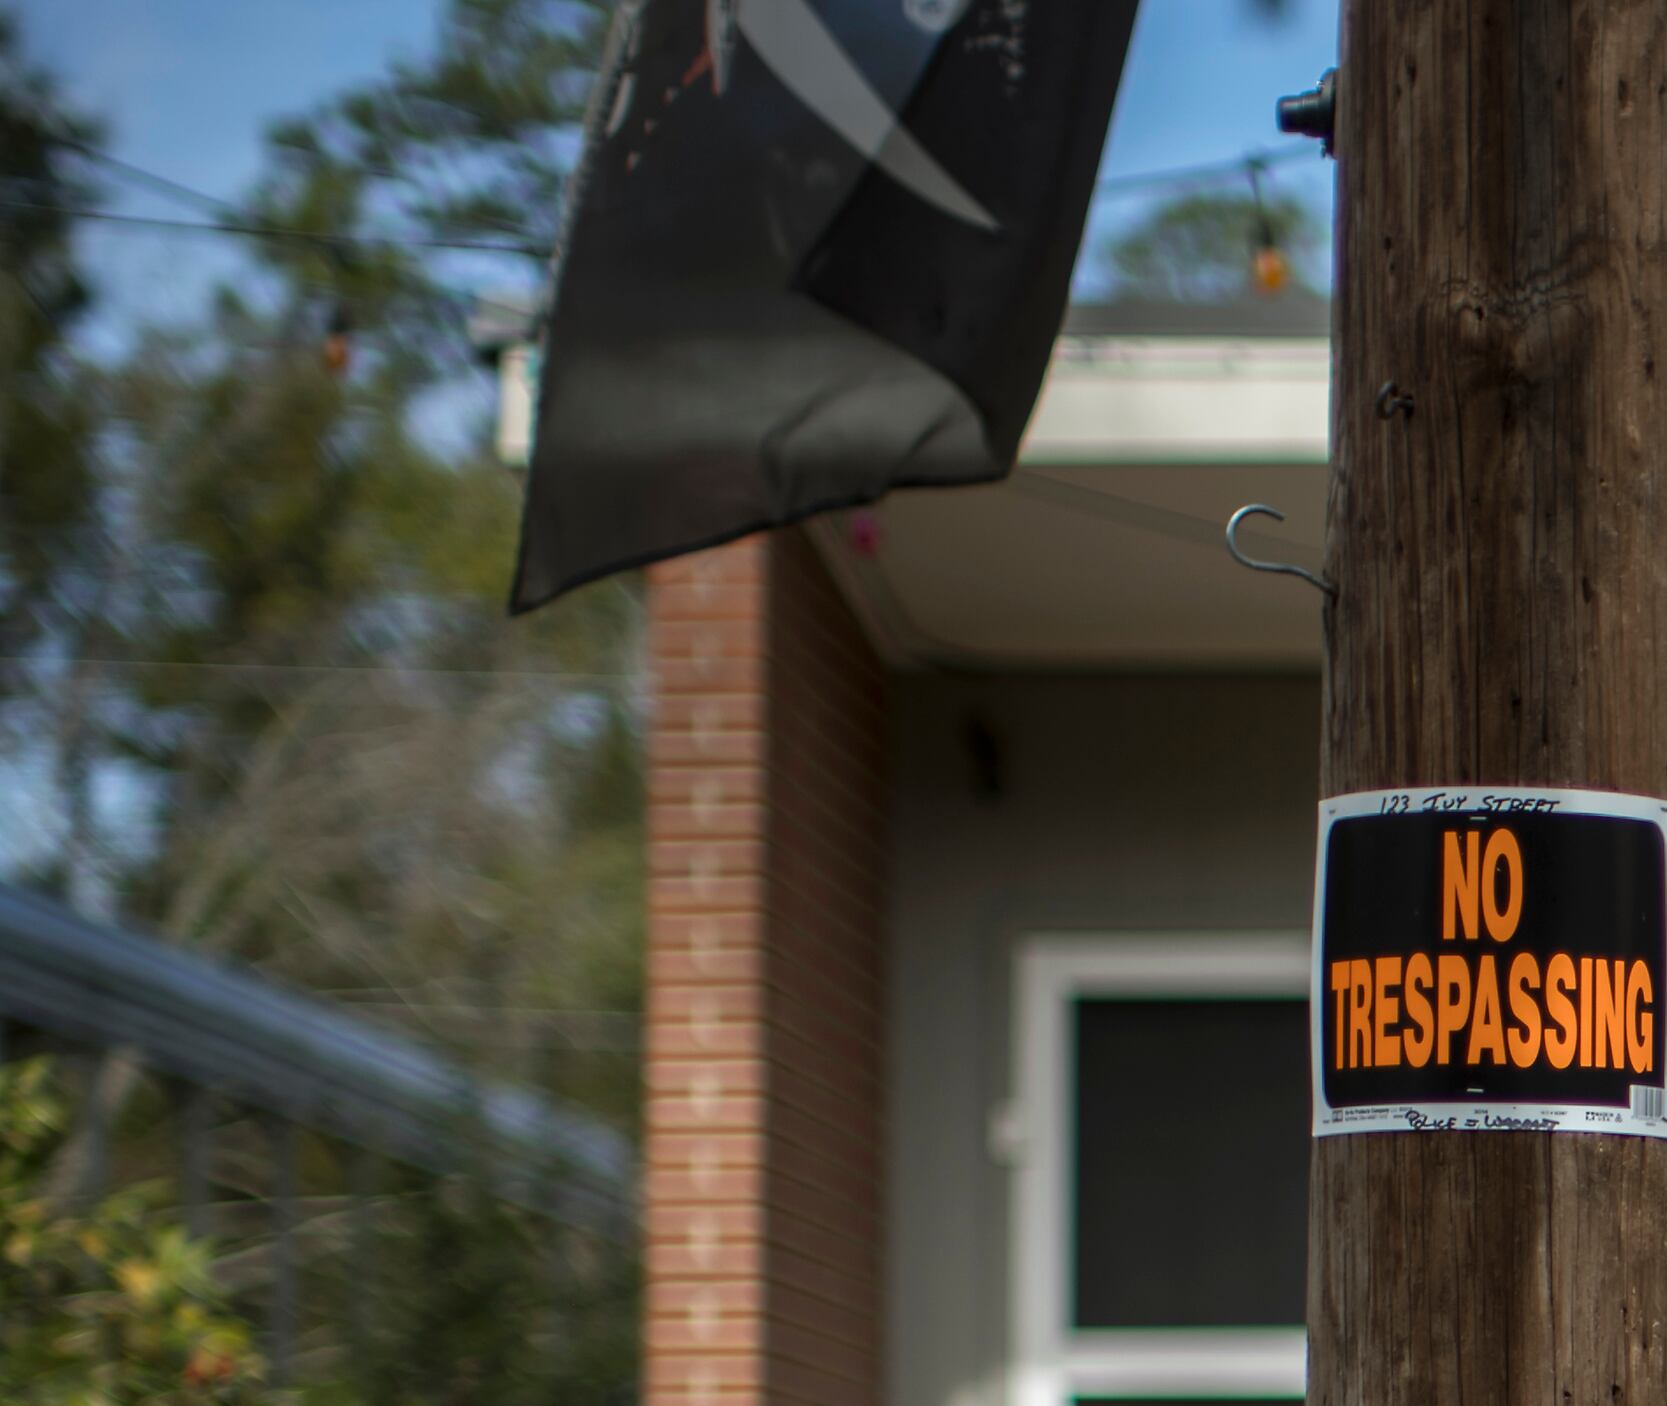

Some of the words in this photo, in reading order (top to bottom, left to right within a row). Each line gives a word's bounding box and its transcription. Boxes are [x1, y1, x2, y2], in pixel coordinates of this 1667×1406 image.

[1380, 795, 1410, 814] 123
[1443, 828, 1524, 942] NO
[1331, 953, 1654, 1074] TRESPASSING
